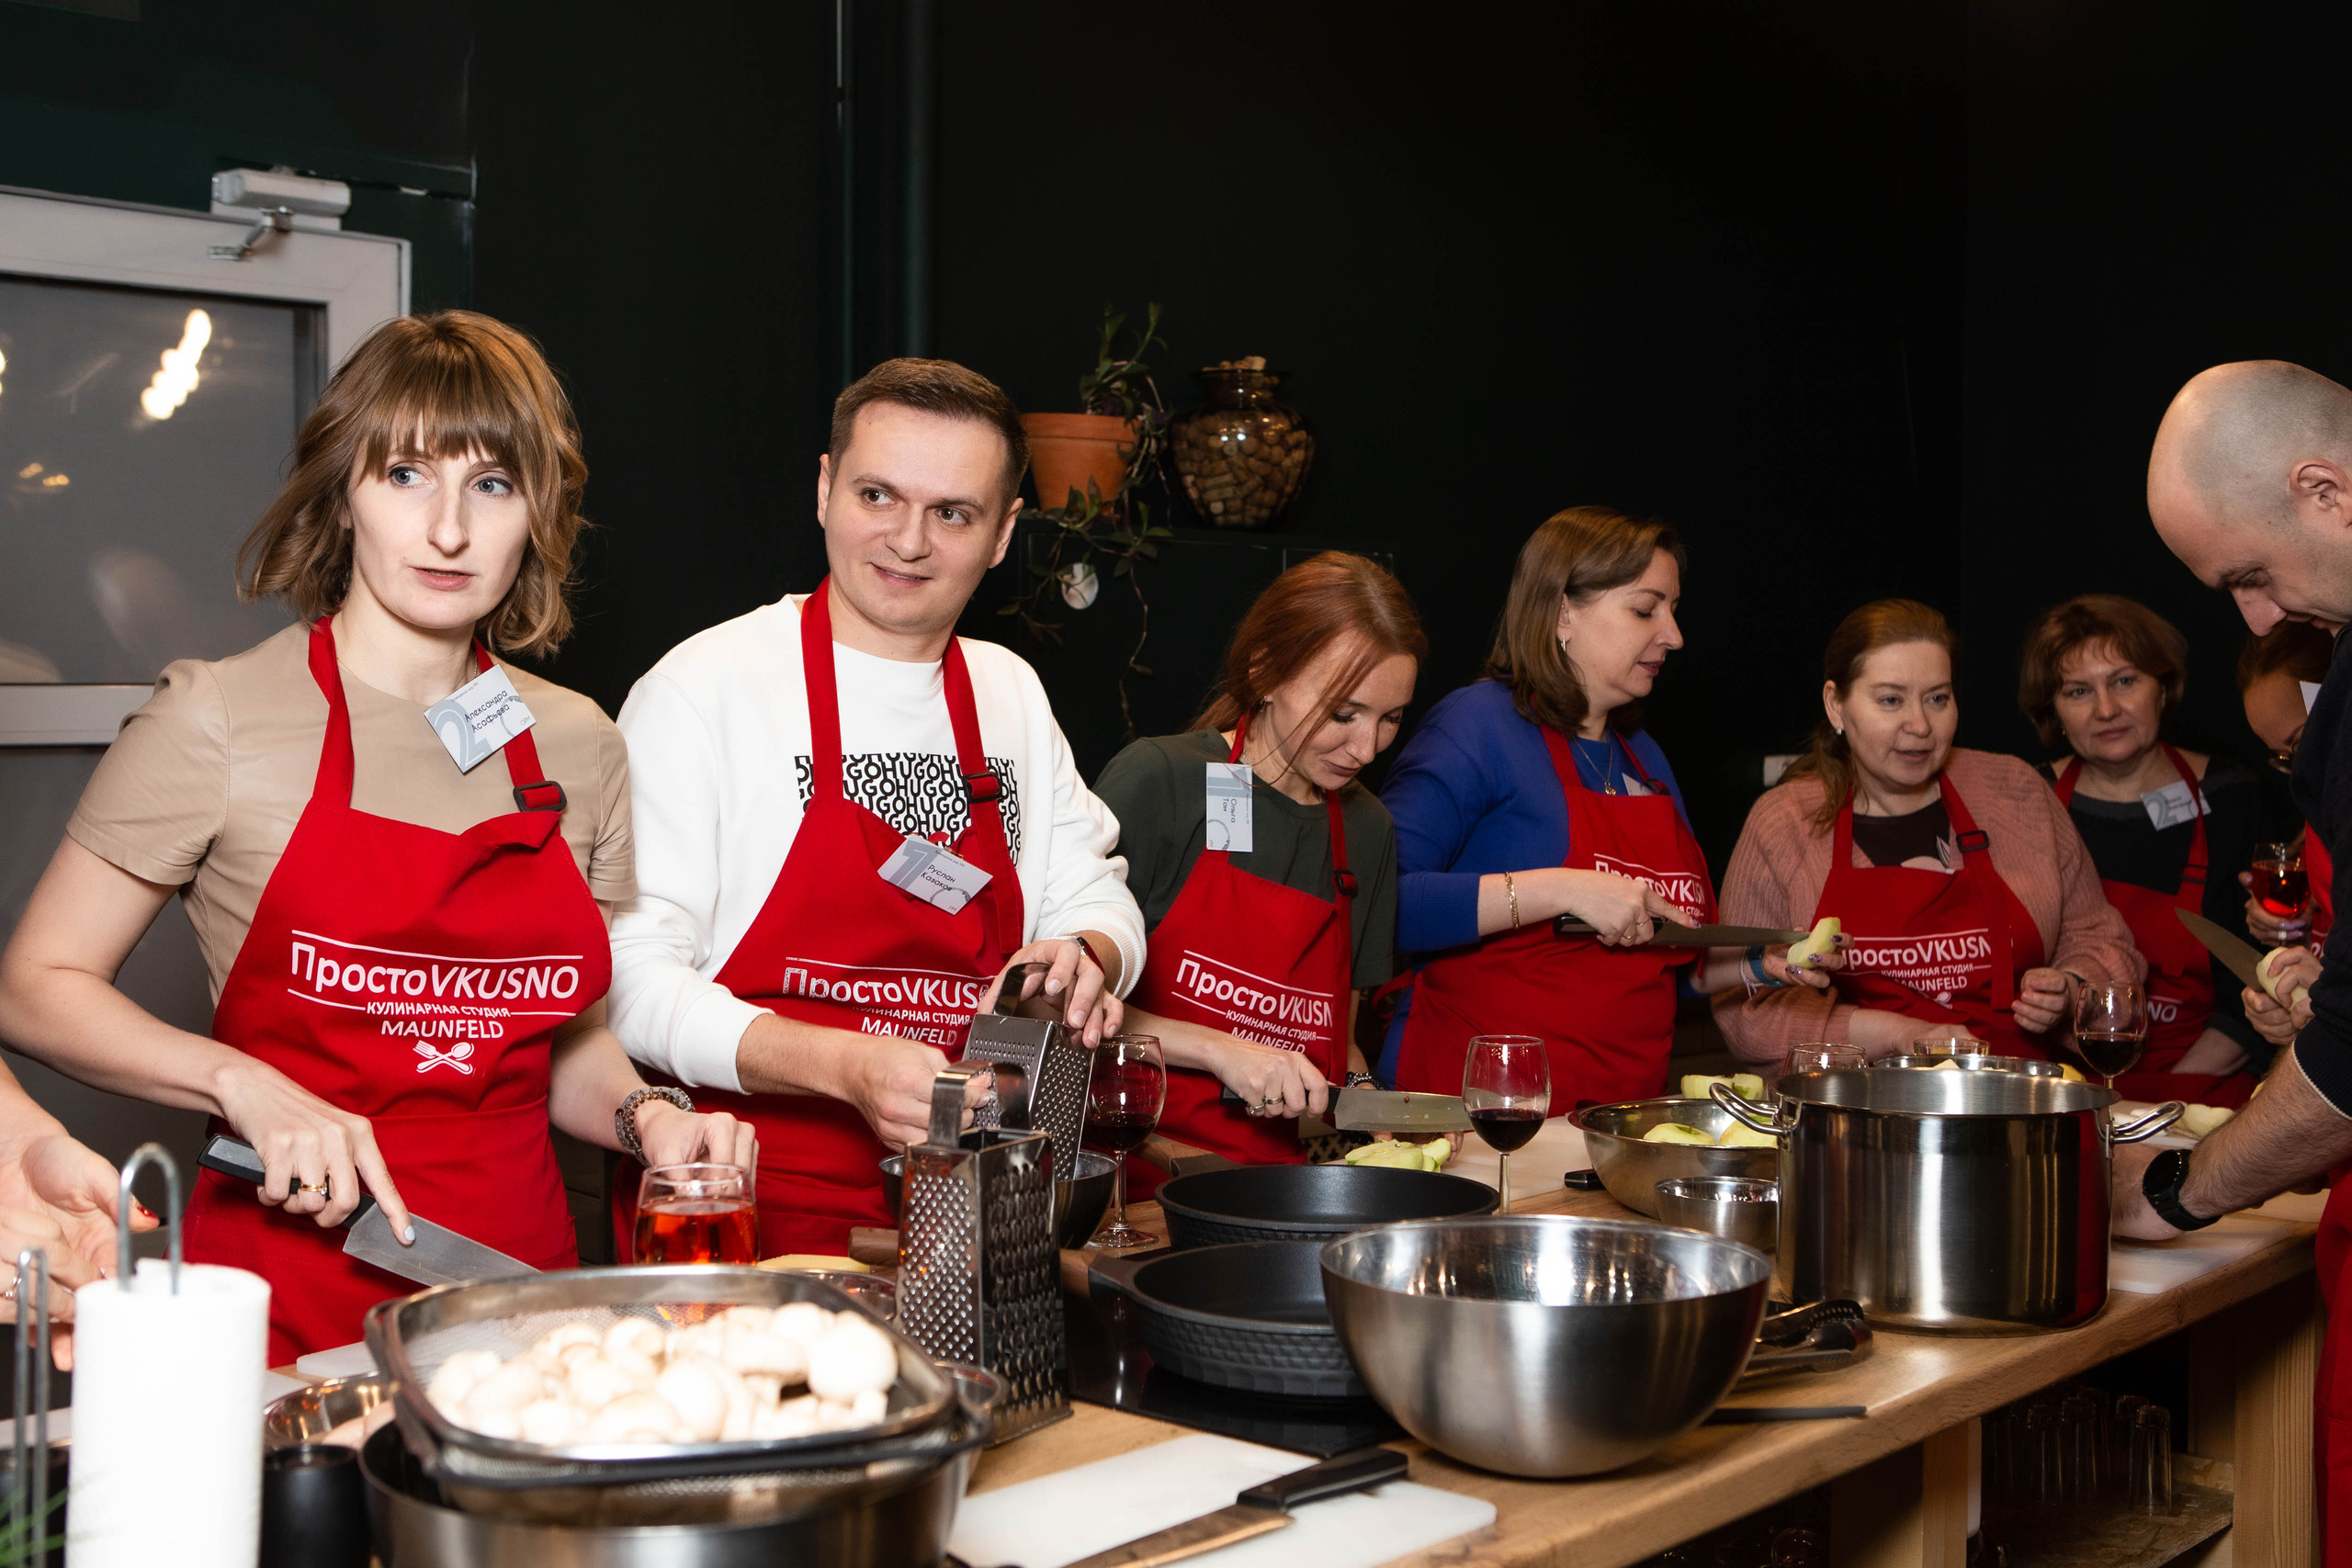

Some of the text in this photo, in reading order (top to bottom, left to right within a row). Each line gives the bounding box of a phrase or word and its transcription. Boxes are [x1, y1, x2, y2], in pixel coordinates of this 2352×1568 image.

[465, 690, 508, 723] Александра
[471, 704, 510, 733] Асафьева
[921, 872, 953, 892] Казаков
[927, 863, 956, 883] Руслан
[1841, 935, 1992, 971] ростоVKUSN
[290, 941, 580, 1000] ПростоVKUSNO
[1941, 963, 1974, 976] СТУДИЯ
[782, 966, 990, 1010] ПростоVKUS
[1175, 958, 1333, 1028] ПростоVKUSN
[367, 1001, 511, 1019] КУЛИНАРНАЯ СТУДИЯ
[932, 1011, 971, 1026] СТУДИЯ
[380, 1020, 504, 1040] MAUNFELD
[861, 1016, 958, 1046] MAUNFELD
[1226, 1010, 1317, 1043] КУЛИНАРНАЯ СТУДИЯ
